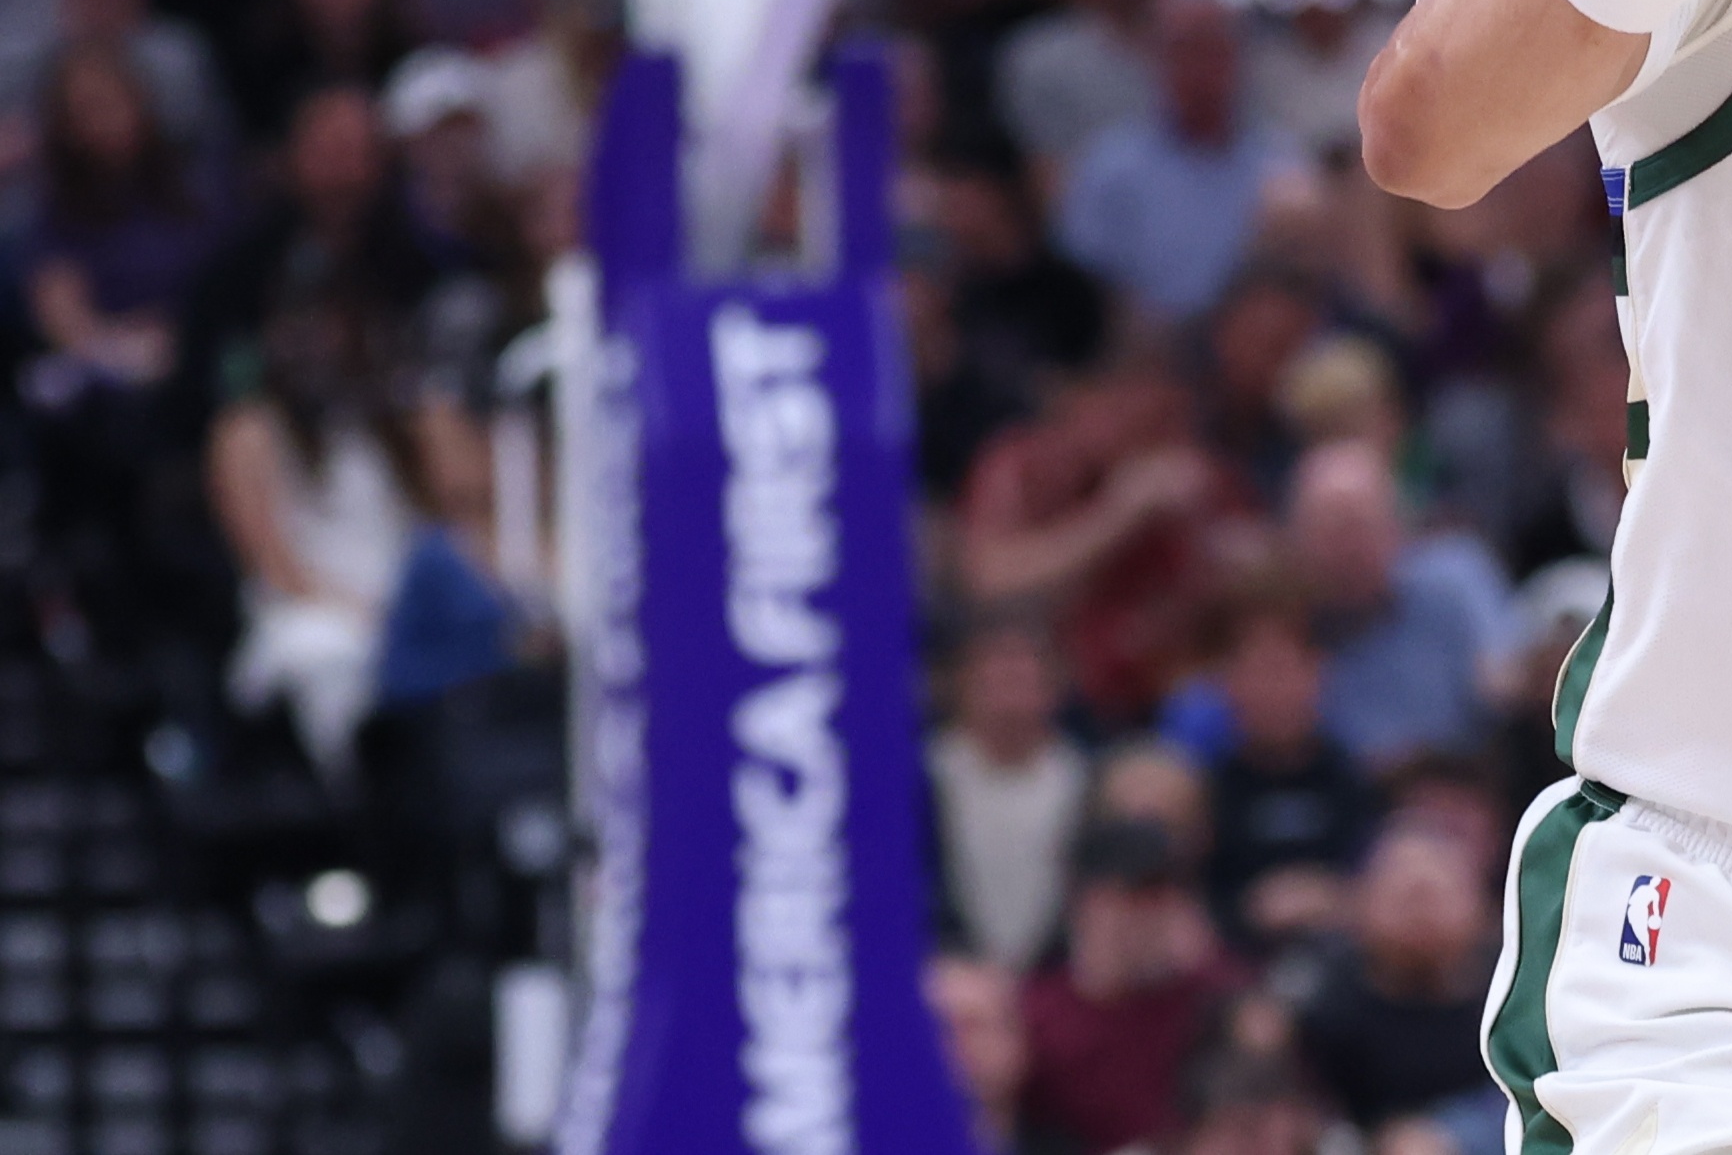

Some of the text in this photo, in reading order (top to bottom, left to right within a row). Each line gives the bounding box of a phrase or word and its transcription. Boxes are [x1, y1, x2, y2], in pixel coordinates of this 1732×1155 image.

[707, 302, 853, 1155] MERICA FIRST
[1622, 942, 1643, 962] NBA
